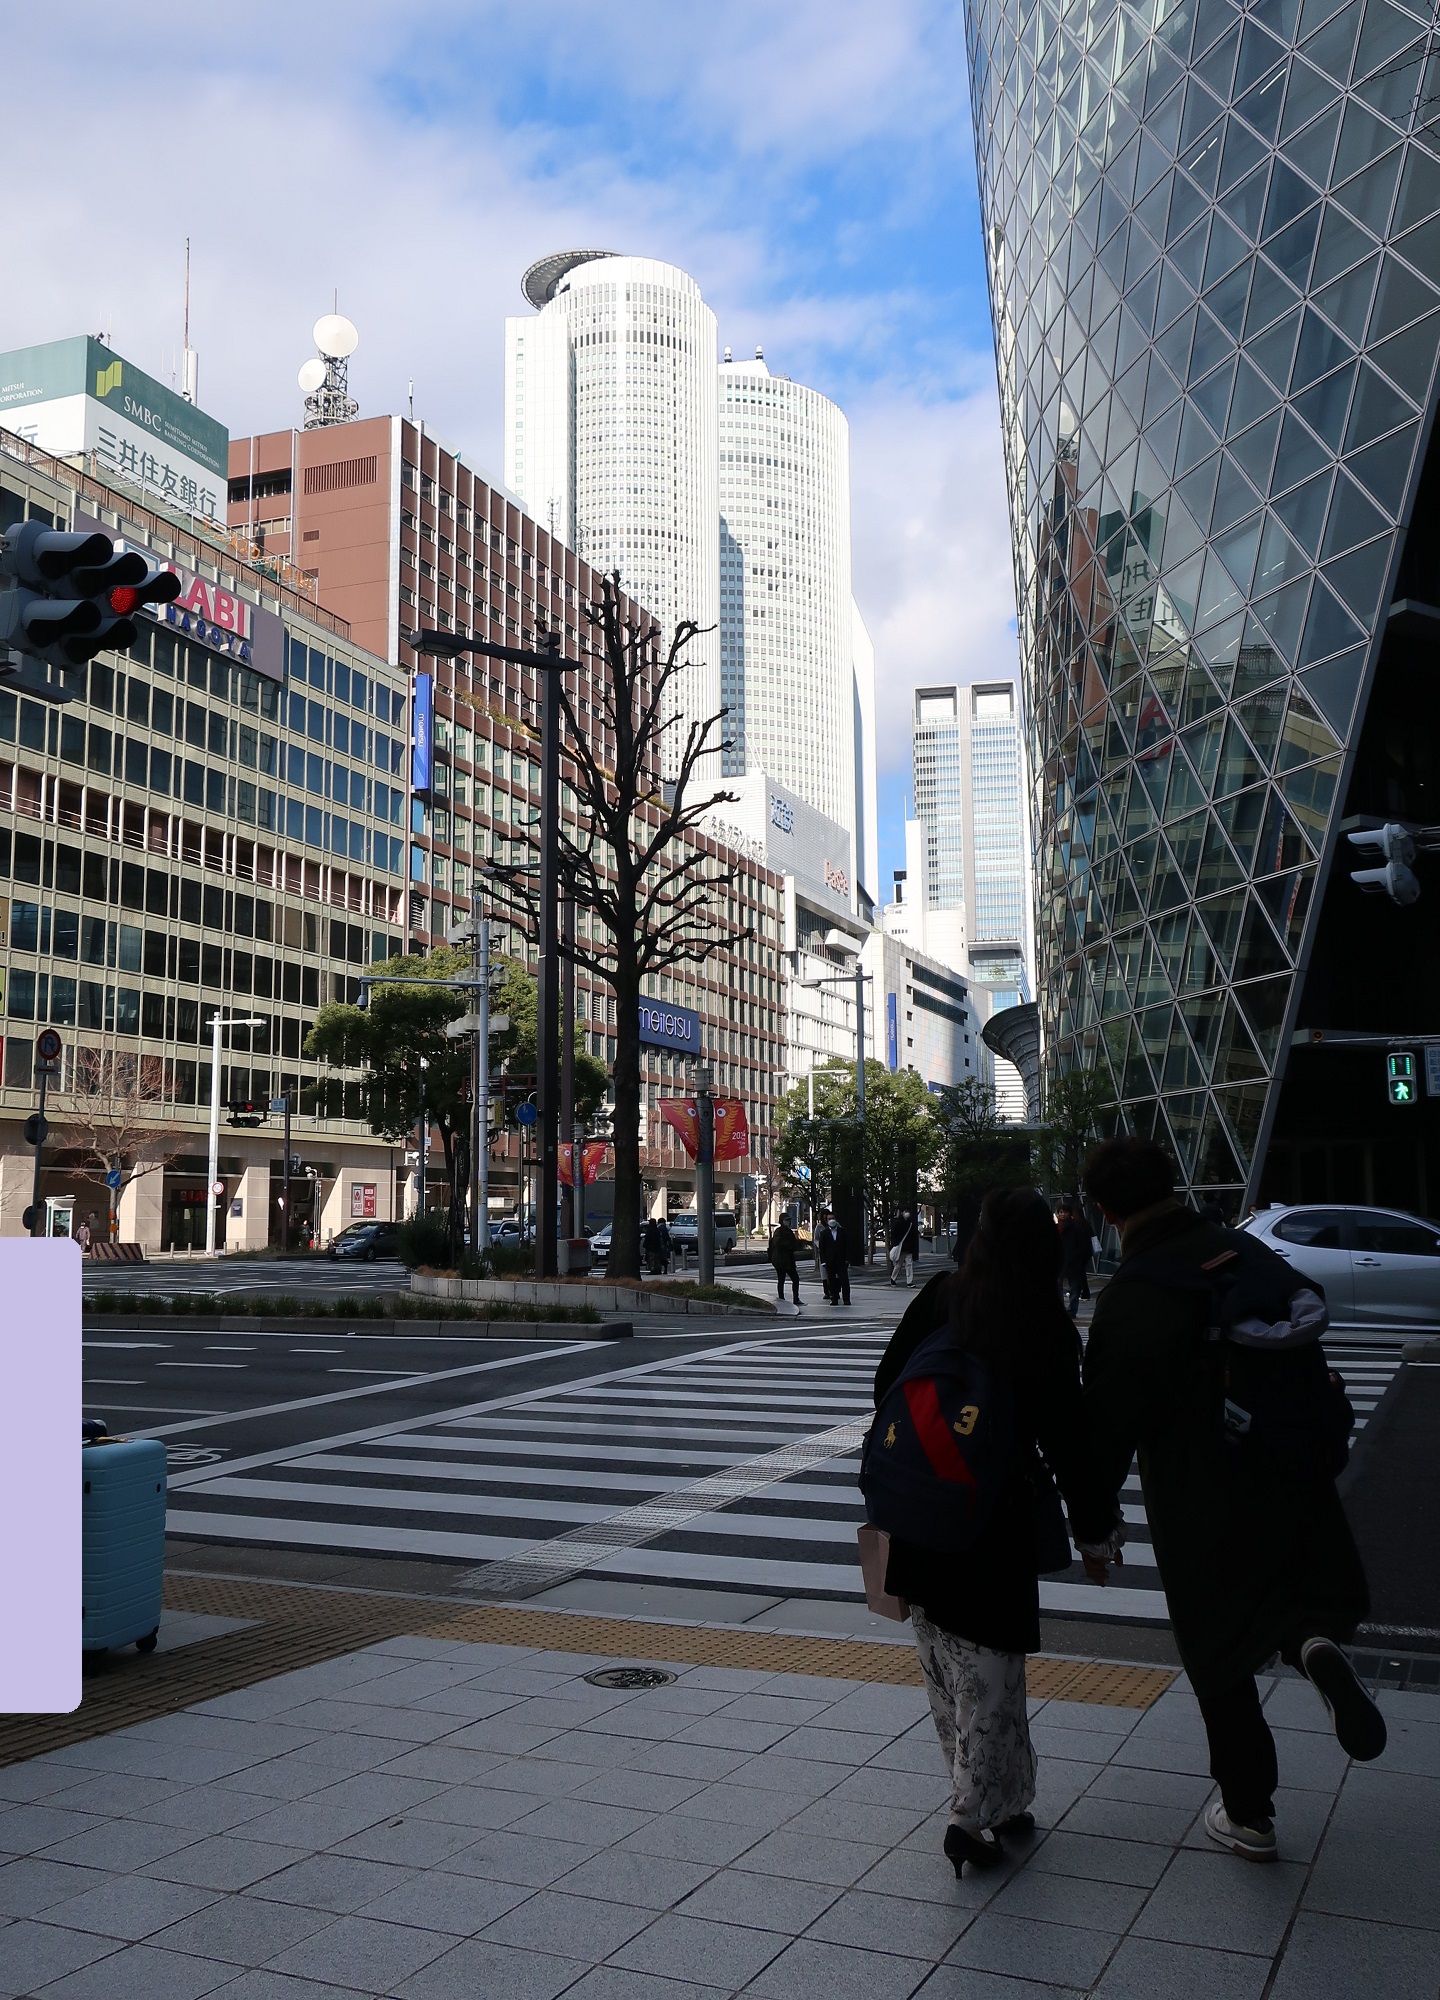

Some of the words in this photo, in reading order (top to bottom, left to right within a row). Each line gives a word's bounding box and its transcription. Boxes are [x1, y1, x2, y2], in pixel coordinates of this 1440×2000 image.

[1, 382, 25, 393] MITSUI
[123, 395, 162, 432] SMBC
[96, 425, 217, 518] 三井住友銀行
[165, 602, 250, 660] NAGOYA
[953, 1405, 980, 1435] 3
